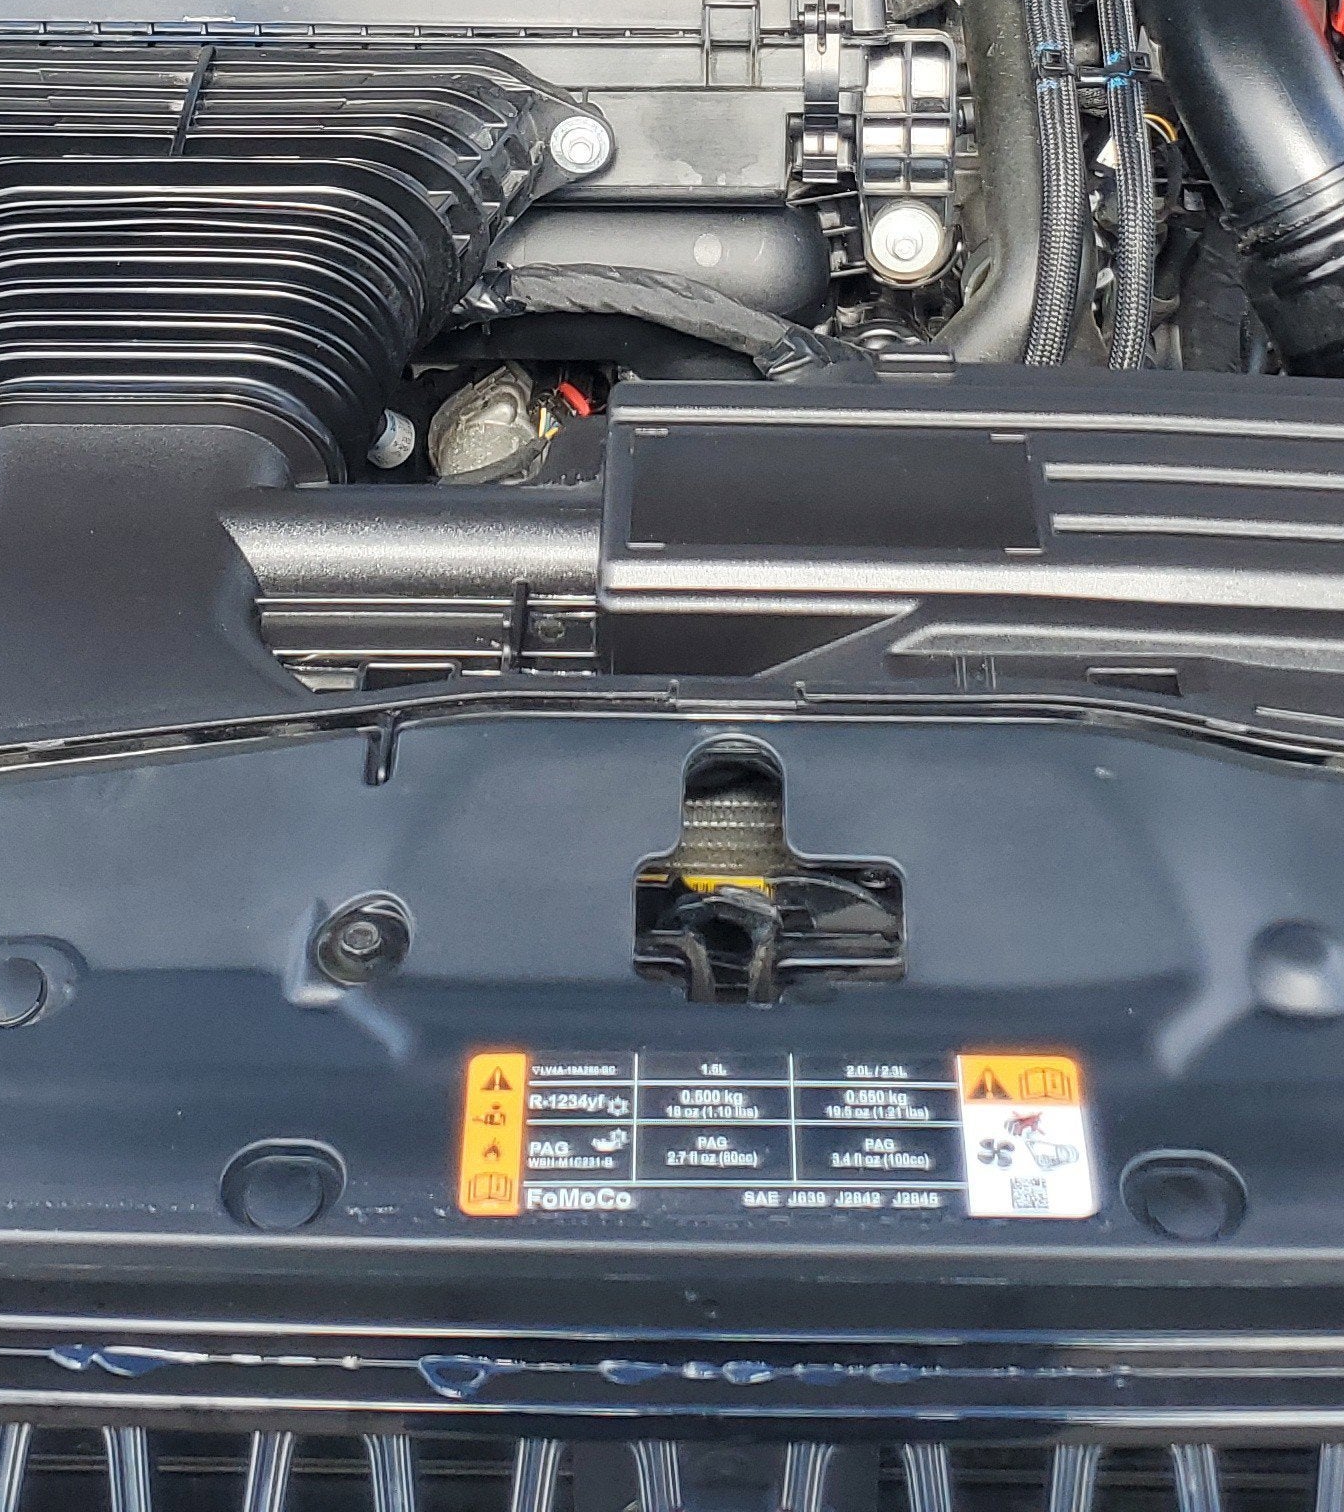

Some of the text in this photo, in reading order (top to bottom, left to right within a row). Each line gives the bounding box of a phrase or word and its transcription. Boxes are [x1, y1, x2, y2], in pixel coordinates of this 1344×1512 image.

[701, 1063, 727, 1076] 1.5L
[846, 1065, 873, 1078] 2.0L
[529, 1093, 605, 1112] R-1234yf
[724, 1089, 743, 1107] kg
[888, 1089, 907, 1106] kg
[684, 1107, 700, 1118] oz
[855, 1107, 871, 1119] oz
[905, 1105, 929, 1120] lbs)
[529, 1141, 570, 1157] PAG
[697, 1136, 728, 1150] PAG
[865, 1138, 895, 1152] PAG
[666, 1151, 686, 1165] 2.7
[701, 1153, 717, 1165] oz
[865, 1155, 881, 1167] oz
[527, 1188, 632, 1210] FoMoCo
[743, 1191, 780, 1207] SAE
